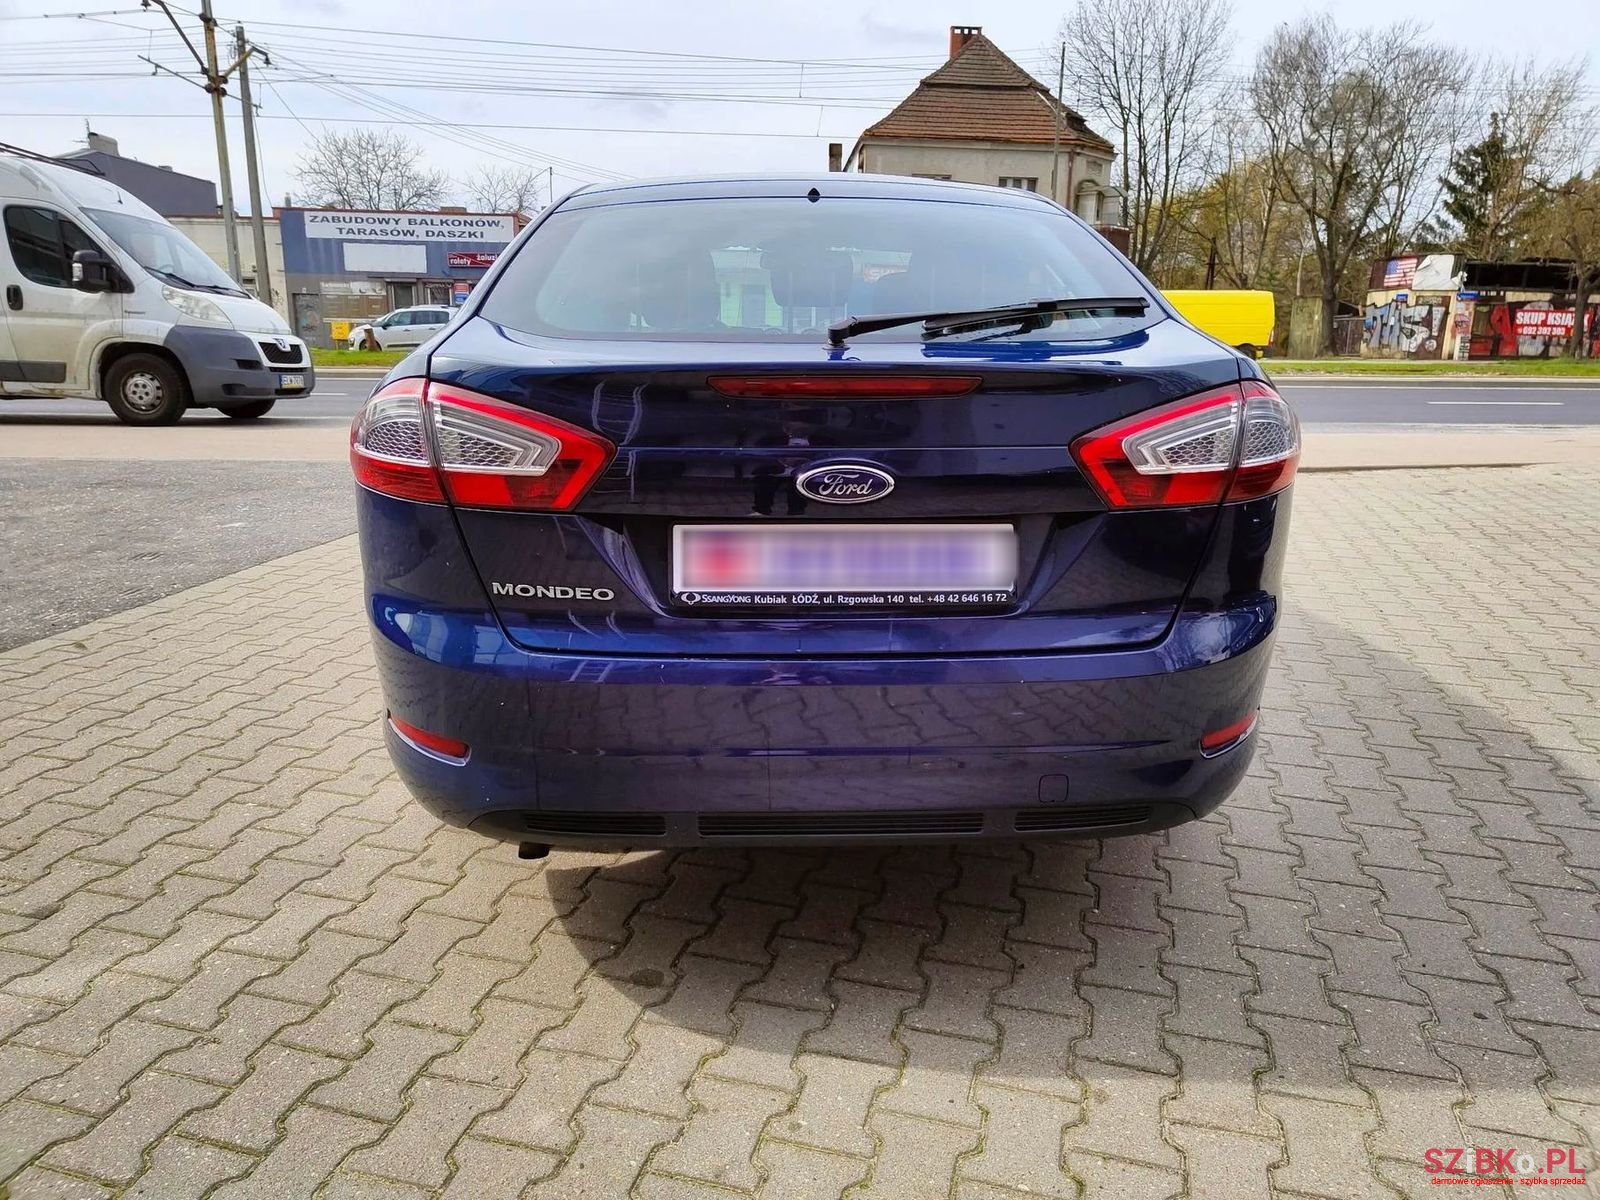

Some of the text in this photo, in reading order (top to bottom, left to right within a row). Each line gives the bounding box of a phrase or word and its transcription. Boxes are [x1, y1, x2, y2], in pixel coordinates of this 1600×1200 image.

[309, 215, 505, 229] ZABUDOWY BALKONÓW,
[336, 226, 484, 239] TARASÓW, DASZKI
[450, 257, 471, 266] rolety
[1516, 311, 1546, 325] SKUP
[819, 473, 873, 495] Ford
[492, 582, 615, 600] MONDEO
[754, 594, 787, 604] Kubiak
[792, 593, 821, 605] ŁÓDŹ,
[823, 594, 835, 604] ul.
[838, 594, 884, 606] Rzgowska
[887, 595, 904, 603] 140
[909, 594, 924, 603] tel.
[927, 594, 945, 603] +48
[947, 594, 959, 603] 42
[961, 594, 979, 602] 646
[982, 593, 993, 602] 16
[995, 593, 1007, 602] 72
